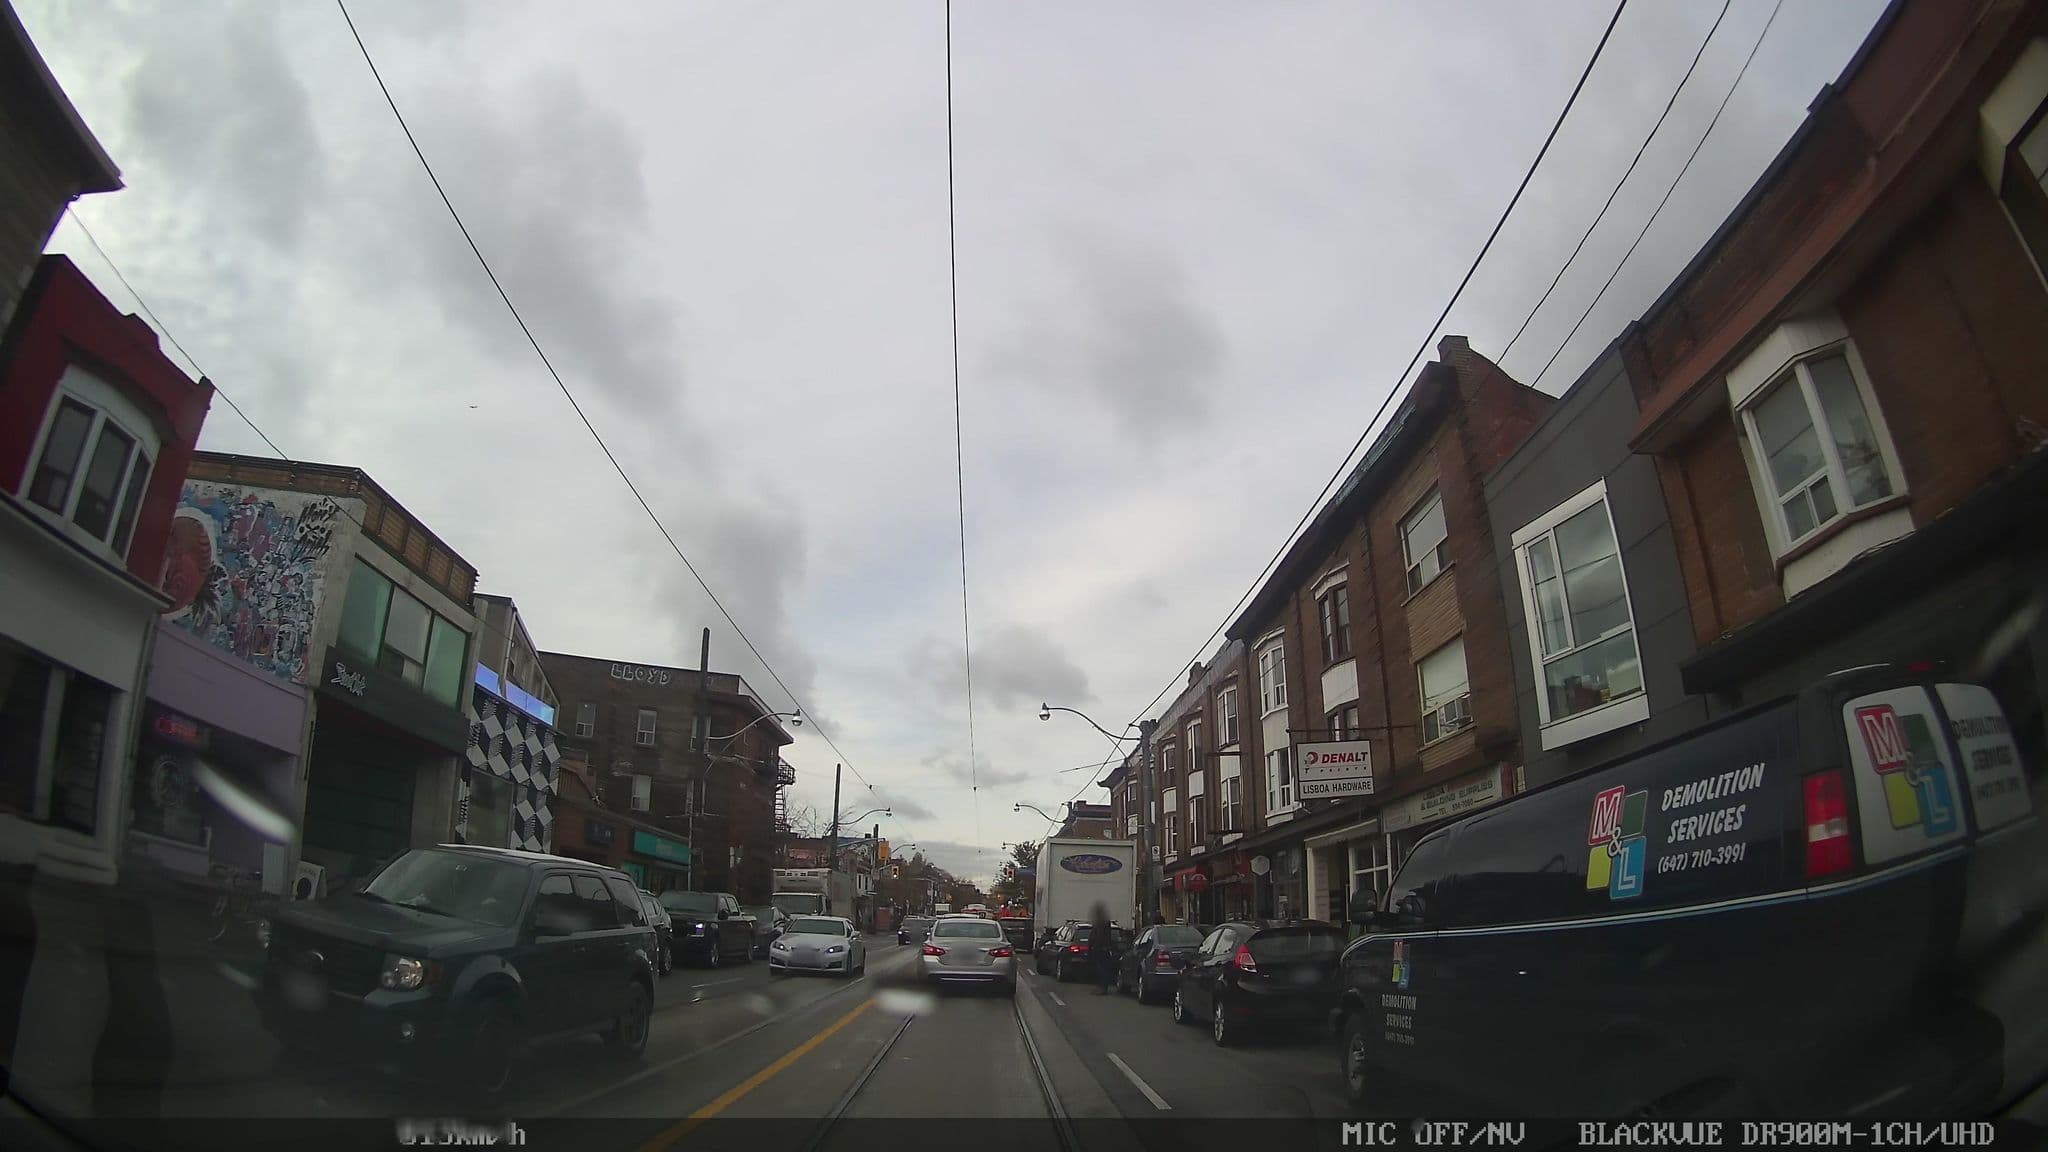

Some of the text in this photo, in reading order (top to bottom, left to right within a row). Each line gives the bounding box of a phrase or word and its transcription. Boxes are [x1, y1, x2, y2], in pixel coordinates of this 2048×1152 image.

[611, 663, 671, 685] LLOYD
[1321, 751, 1368, 764] DENALT
[1303, 781, 1372, 794] LISBOA HARDWARE
[1660, 763, 1766, 811] DEMOLITION
[1667, 804, 1747, 844] SERVICES
[1592, 792, 1637, 891] M & L
[1657, 842, 1747, 874] (647) 710-3991
